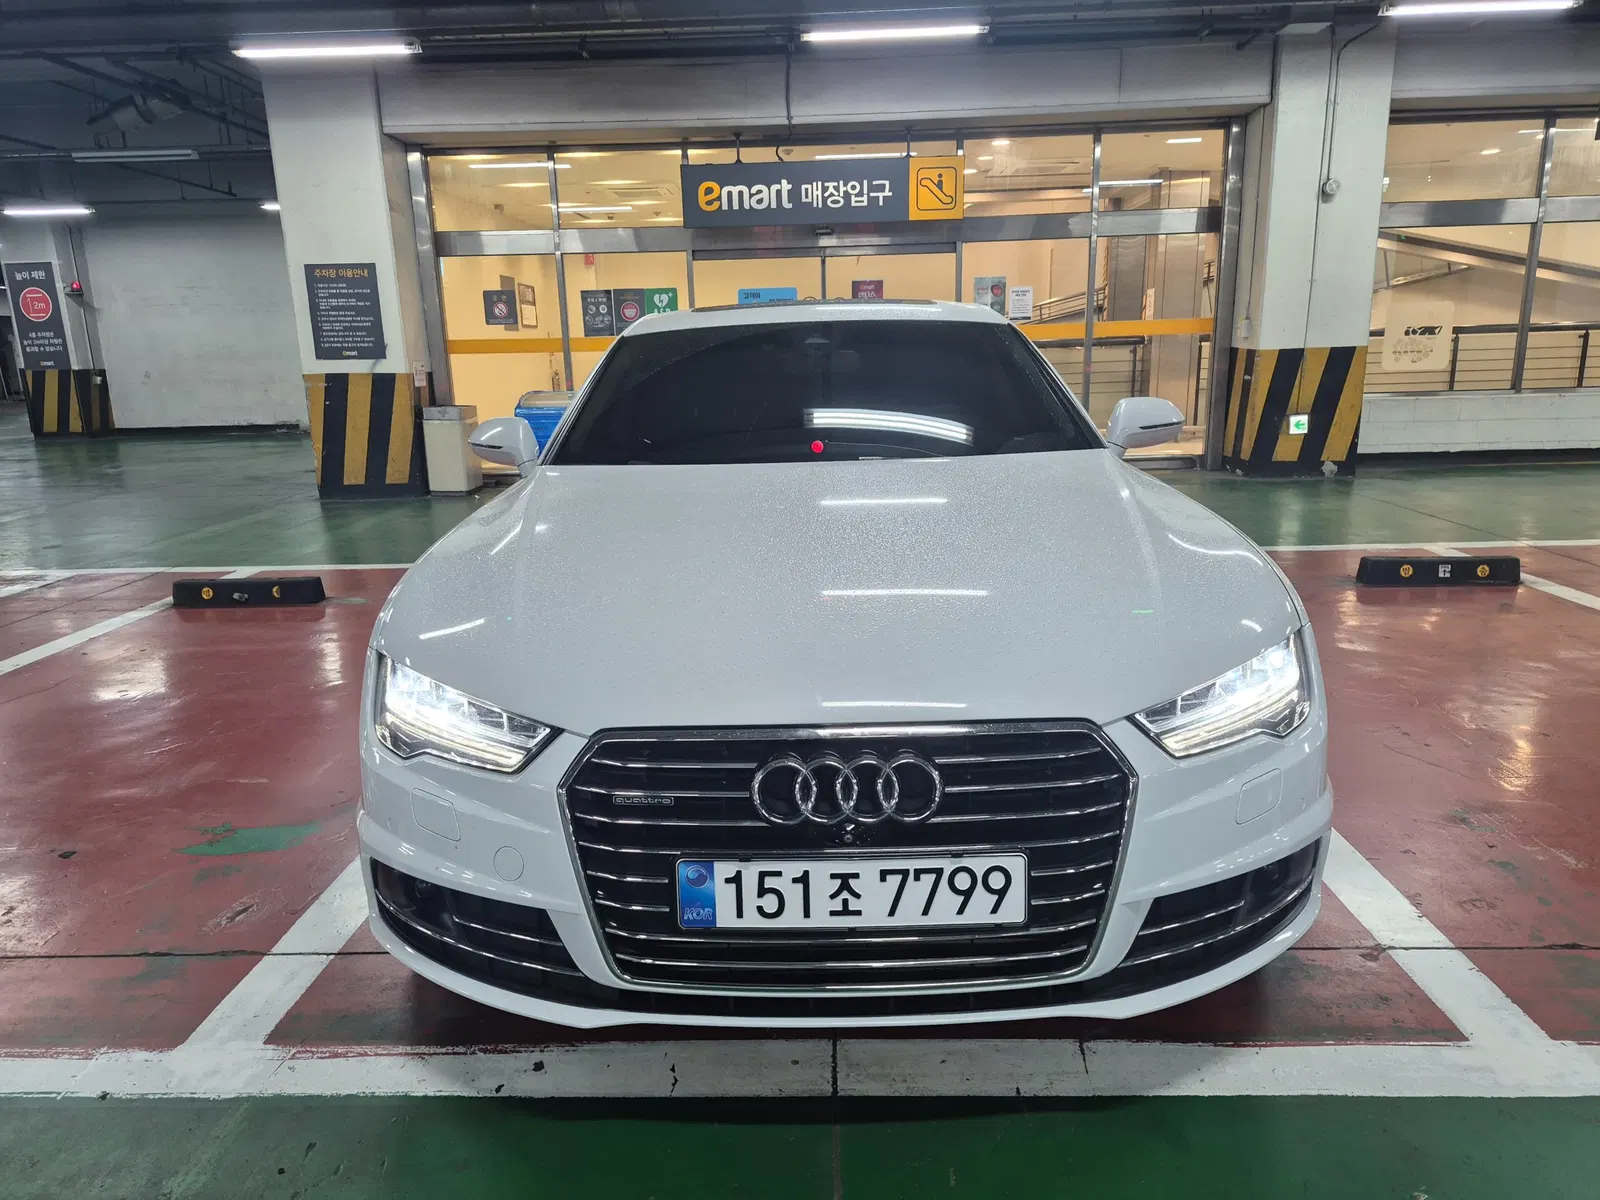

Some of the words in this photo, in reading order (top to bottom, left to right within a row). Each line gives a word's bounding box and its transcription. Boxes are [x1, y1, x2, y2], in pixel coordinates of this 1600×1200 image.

[697, 178, 793, 213] emart
[801, 178, 894, 209] 매장입구
[14, 270, 30, 281] 높이
[30, 269, 46, 280] 제한
[314, 268, 337, 278] 주차장
[338, 268, 369, 279] 이용안내
[33, 301, 46, 310] 2m
[615, 796, 672, 806] quattro
[723, 868, 864, 919] 151조
[878, 864, 1014, 918] 7799
[683, 907, 714, 921] KOR
